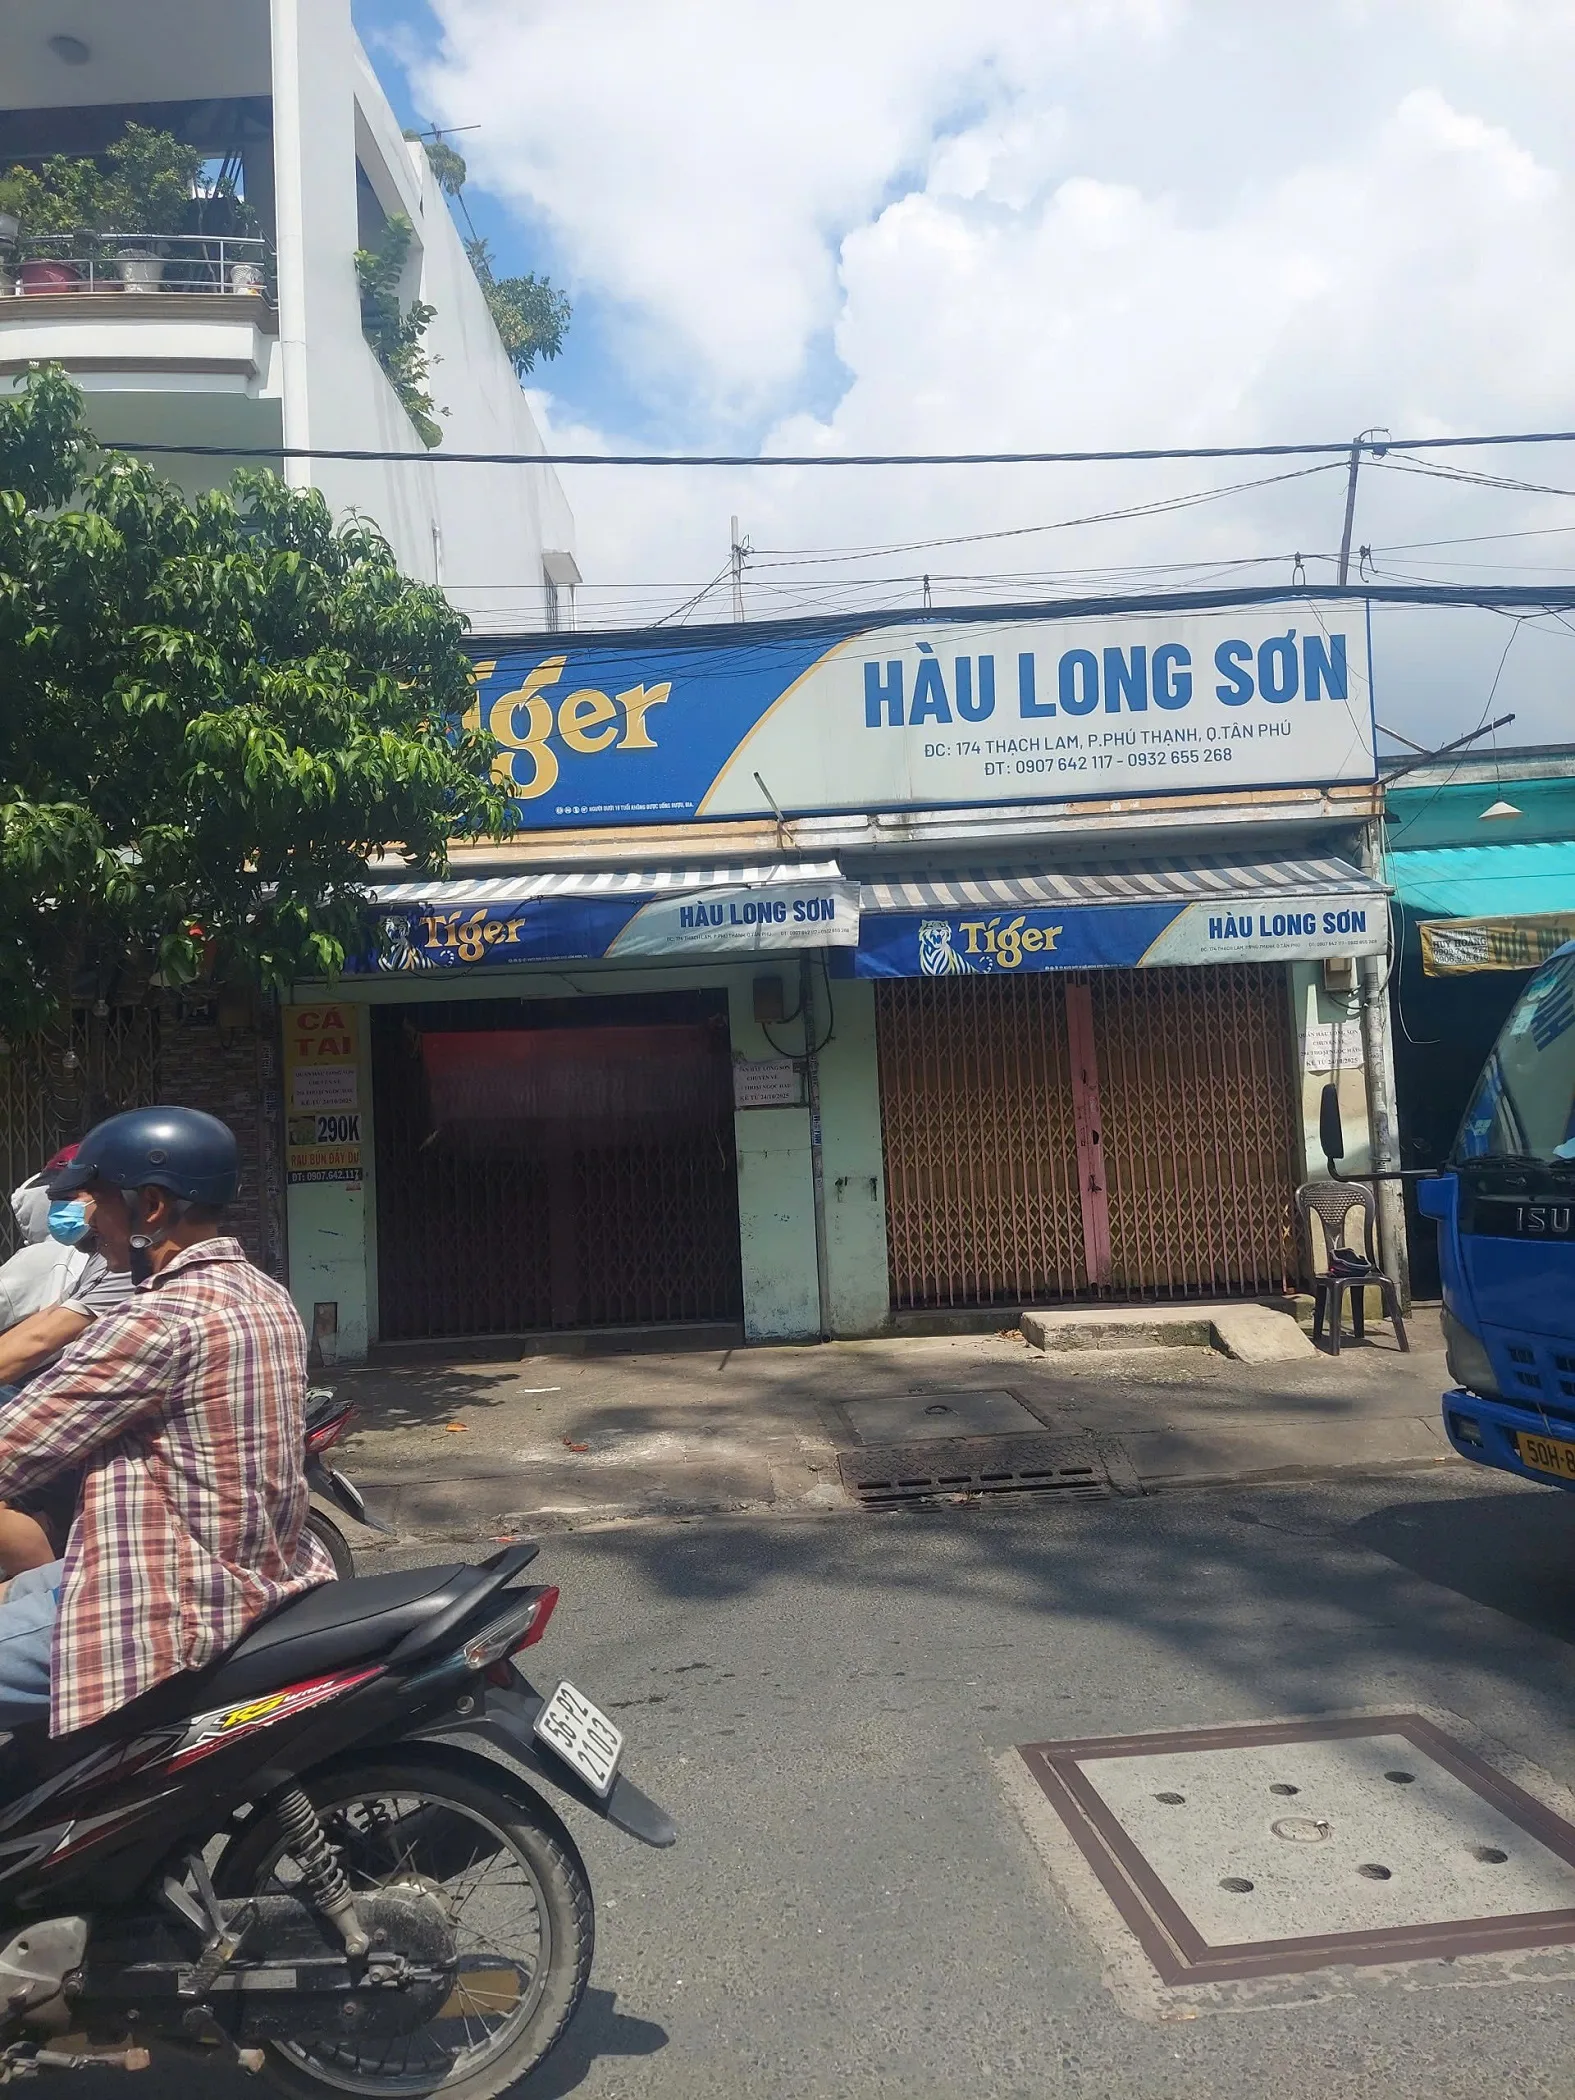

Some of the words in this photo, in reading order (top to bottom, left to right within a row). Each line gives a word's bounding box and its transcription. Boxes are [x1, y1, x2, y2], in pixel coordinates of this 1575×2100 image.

[864, 641, 996, 728] HÀU
[1018, 643, 1192, 719] LONG
[1214, 628, 1348, 707] SƠN
[925, 743, 951, 757] ĐC:
[956, 741, 981, 755] 174
[985, 738, 1040, 756] THẠCH
[1044, 735, 1083, 750] LAM,
[1088, 728, 1136, 748] P.PHÚ
[1141, 728, 1202, 746] THẠNH,
[1206, 722, 1253, 742] Q.TÂN
[1258, 719, 1291, 737] PHÚ
[984, 761, 1010, 775] ĐT:
[1015, 759, 1054, 774] 0907
[1058, 756, 1087, 771] 642
[1092, 755, 1113, 769] 117
[1128, 752, 1166, 767] 0932
[1171, 750, 1199, 764] 655
[1204, 747, 1232, 762] 268
[680, 900, 724, 928] HÀU
[730, 901, 787, 925] LONG
[793, 896, 835, 922] SƠN
[1208, 912, 1253, 939] HÀU
[1259, 913, 1316, 937] LONG
[1322, 909, 1366, 934] SƠN
[420, 908, 526, 962] Tiger
[959, 916, 1063, 968] Tiger
[297, 1007, 345, 1030] CÁ
[293, 1036, 351, 1056] TAI
[318, 1115, 360, 1142] 290K
[1517, 1207, 1571, 1233] ISU
[544, 1688, 589, 1748] 56-P2
[577, 1717, 618, 1783] 2103
